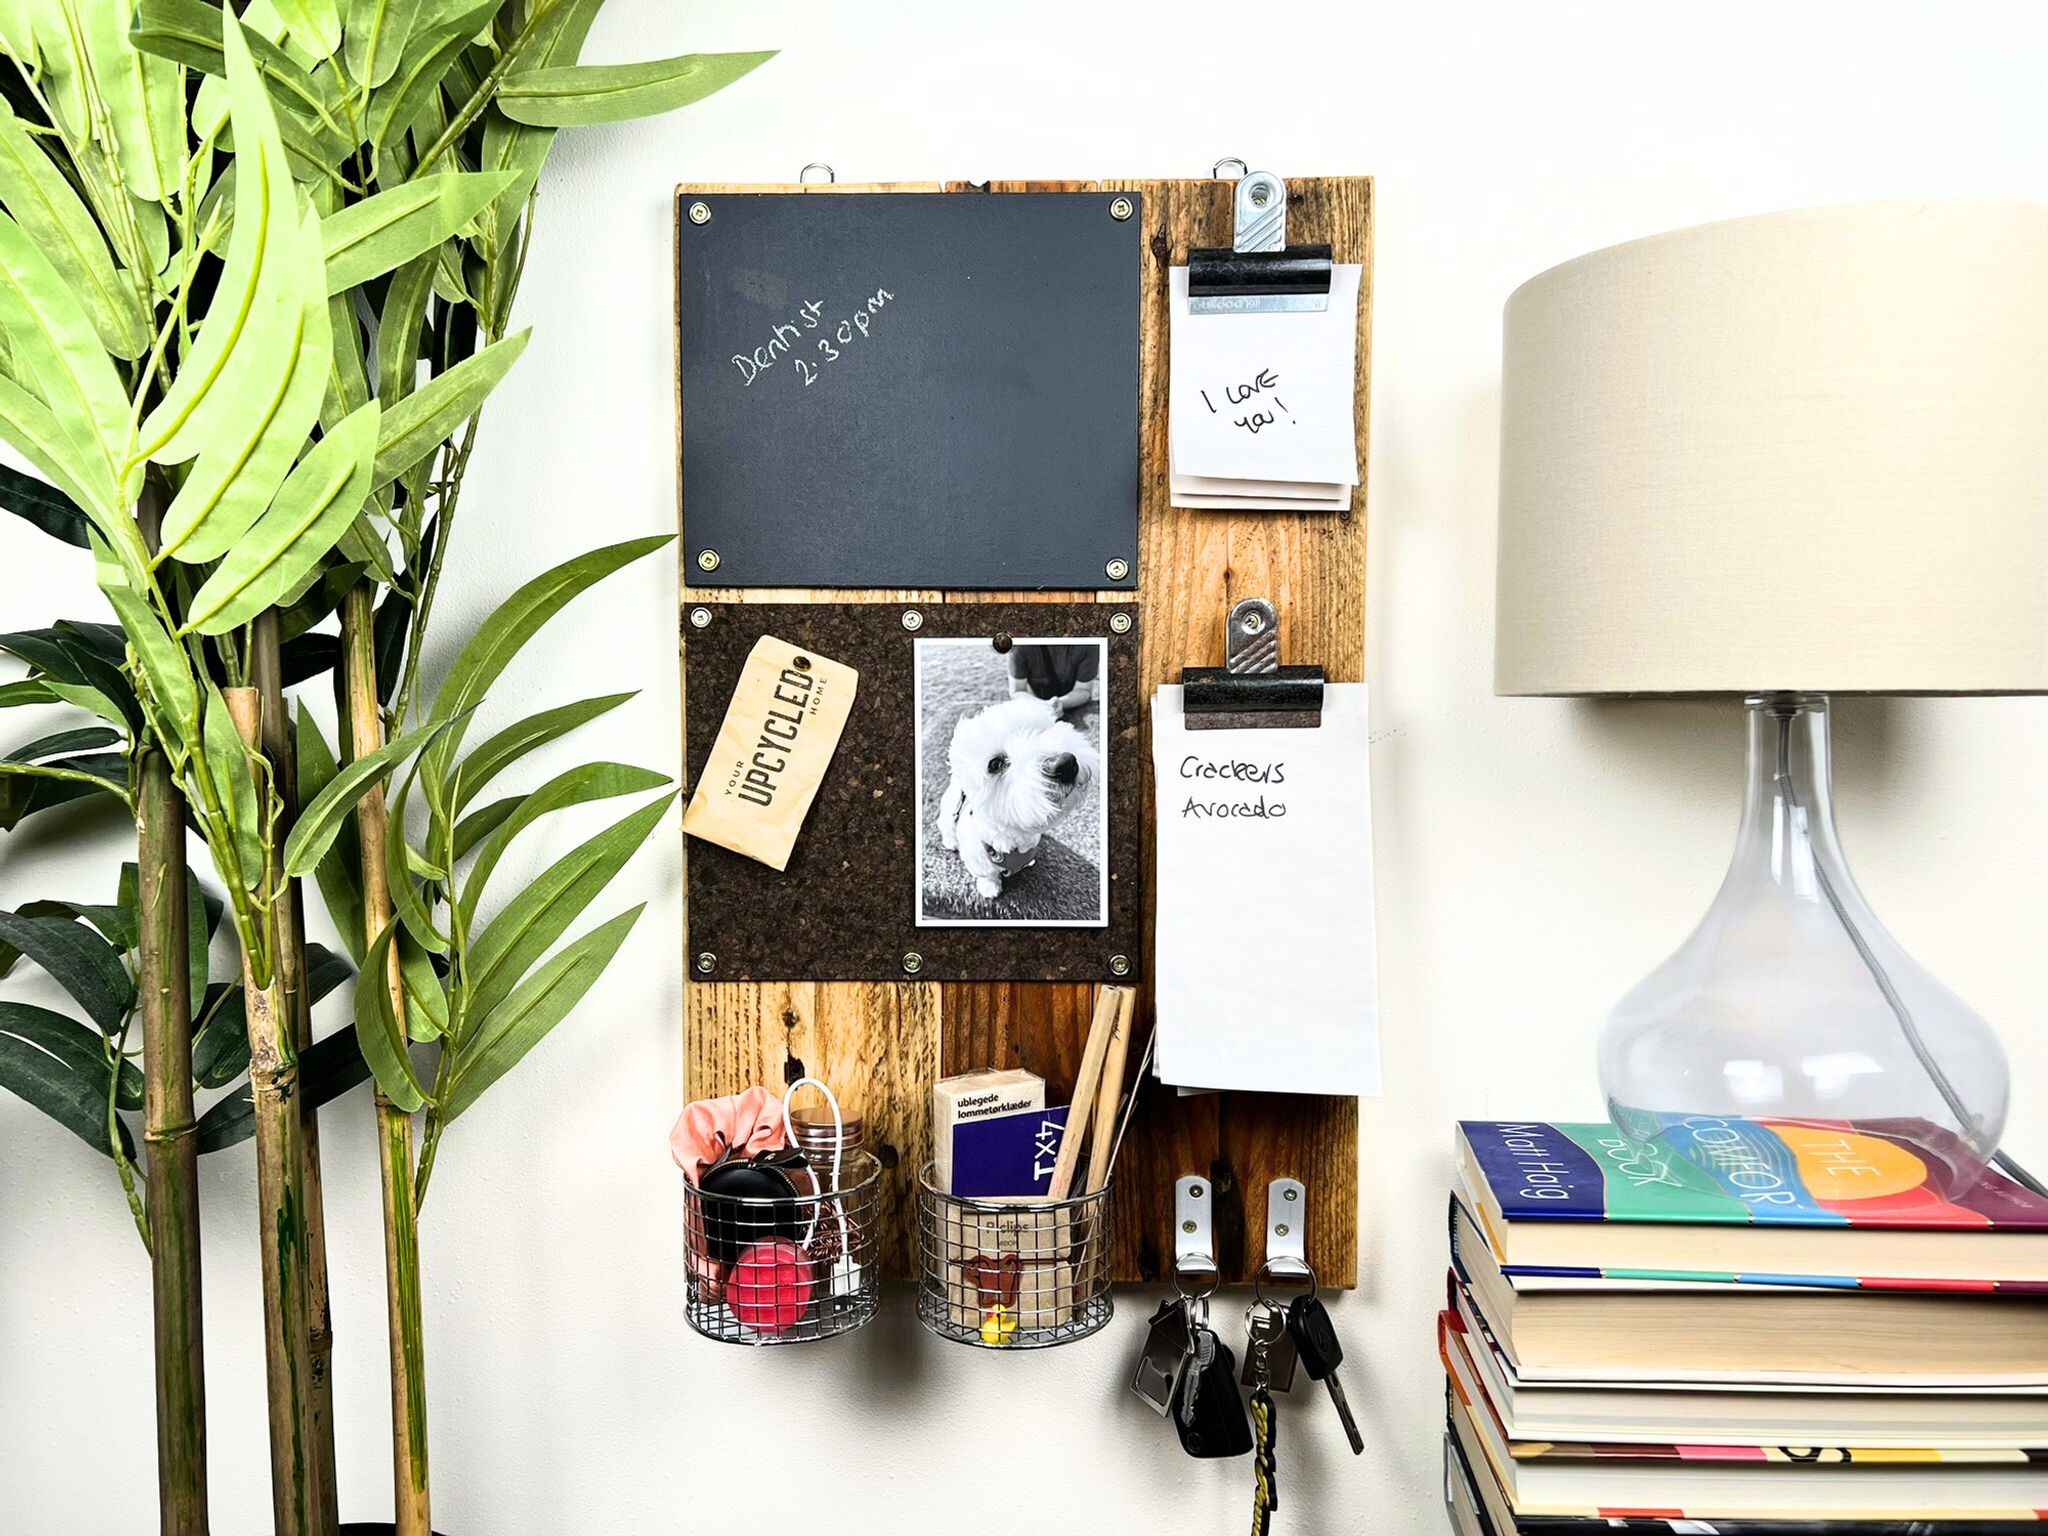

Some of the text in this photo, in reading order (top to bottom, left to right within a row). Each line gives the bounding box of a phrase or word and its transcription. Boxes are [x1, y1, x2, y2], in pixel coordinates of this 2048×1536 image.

[731, 299, 824, 386] Dentist
[794, 288, 895, 386] 2.30pm
[1200, 389, 1217, 413] I
[809, 677, 828, 716] HOME
[738, 669, 814, 807] UPCYCLED
[725, 760, 745, 796] YOUR
[1180, 755, 1285, 784] Crackers
[1181, 795, 1287, 819] Avocado
[957, 1093, 999, 1107] ublegede
[1496, 1123, 1575, 1200] Matt Haig
[1683, 1116, 1804, 1209] COMFOR
[1800, 1138, 1882, 1176] THE
